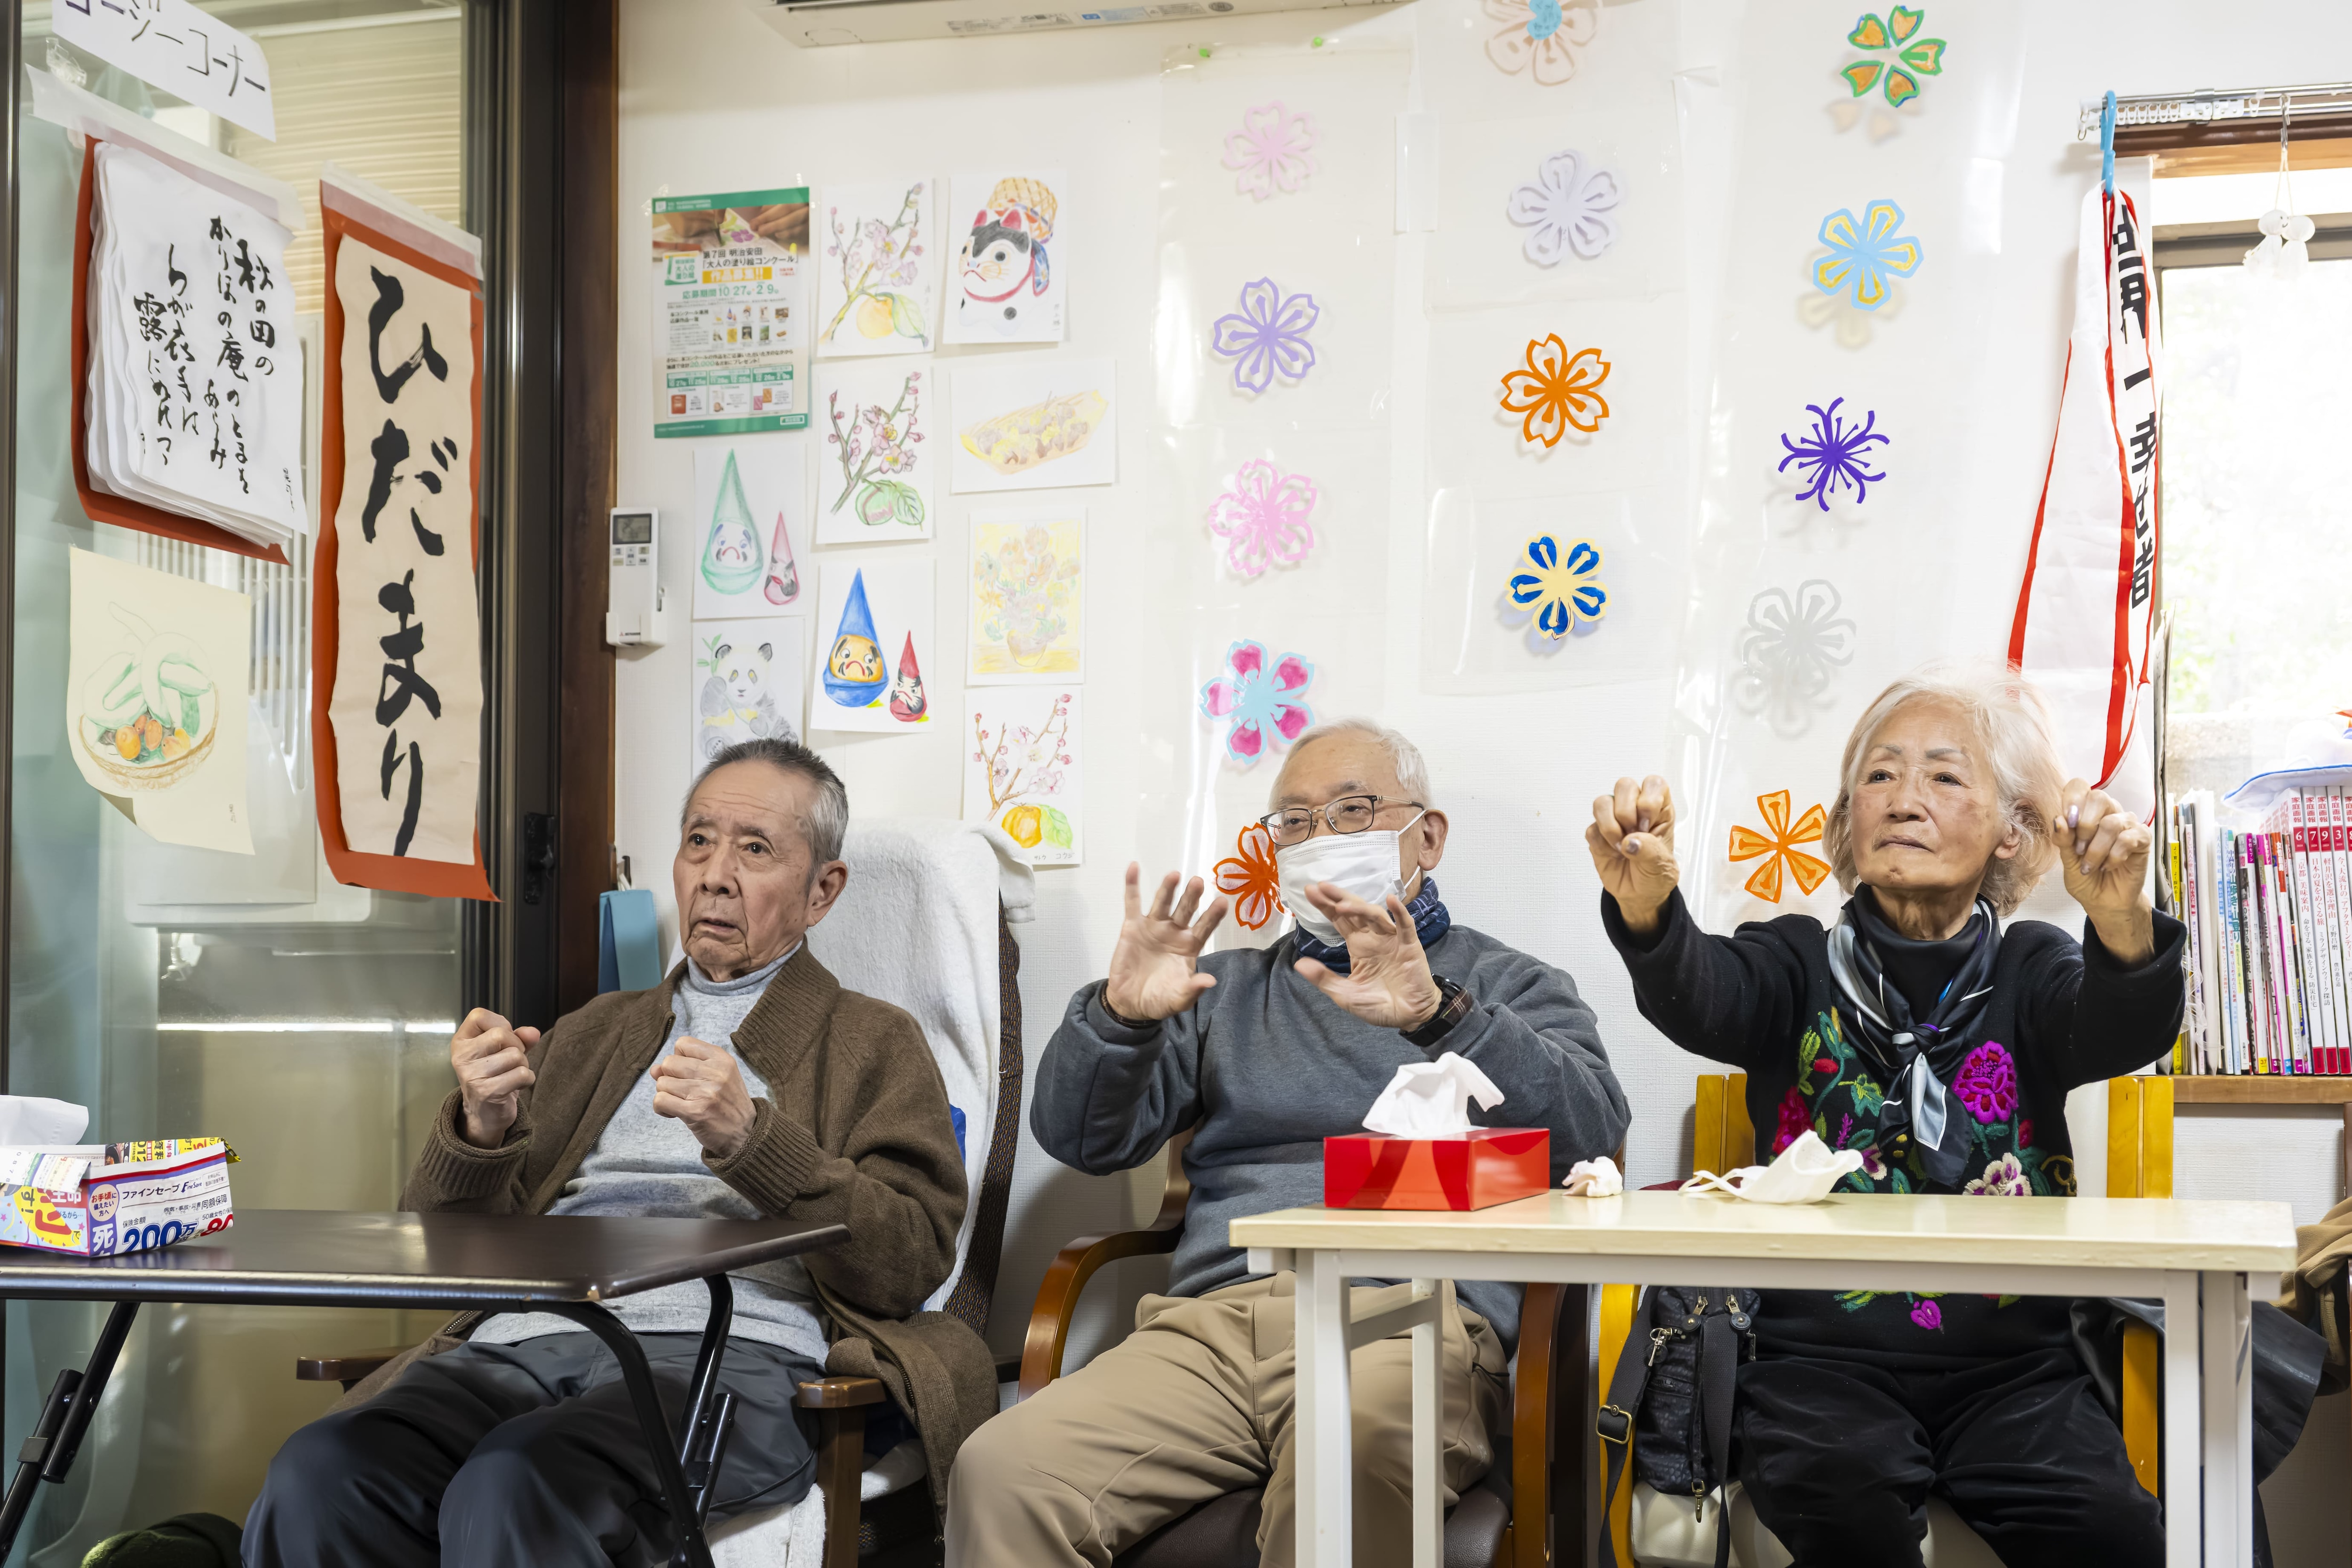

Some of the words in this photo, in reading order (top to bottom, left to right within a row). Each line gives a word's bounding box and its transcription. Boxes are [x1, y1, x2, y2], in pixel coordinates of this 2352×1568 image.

[729, 247, 762, 257] 明治安田
[703, 255, 799, 269] 「大人の塗り絵コンクール」
[683, 288, 716, 300] 応募期間
[233, 239, 275, 375] 秋の田の
[361, 263, 459, 857] ひだまり
[2291, 797, 2303, 823] 家庭画報
[2306, 797, 2316, 823] 家庭画報
[2318, 796, 2328, 822] 家庭画報
[2331, 795, 2341, 821] 家庭画報
[2296, 831, 2302, 841] 6
[2310, 831, 2317, 841] 7
[2321, 831, 2328, 841] 9
[2336, 830, 2342, 840] 3
[2298, 859, 2309, 913] 「京都」美味案内
[2312, 858, 2324, 925] 日本の夏をめぐる旅
[2324, 858, 2336, 919] 軽井沢を選ぶ理由
[2230, 874, 2240, 943] 山歩き・山登り
[91, 1192, 117, 1203] お手頃に
[122, 1184, 180, 1200] ファインセーブ
[94, 1201, 114, 1210] 備えたい
[201, 1194, 228, 1210] 同額保障
[123, 1217, 146, 1228] 保険金額
